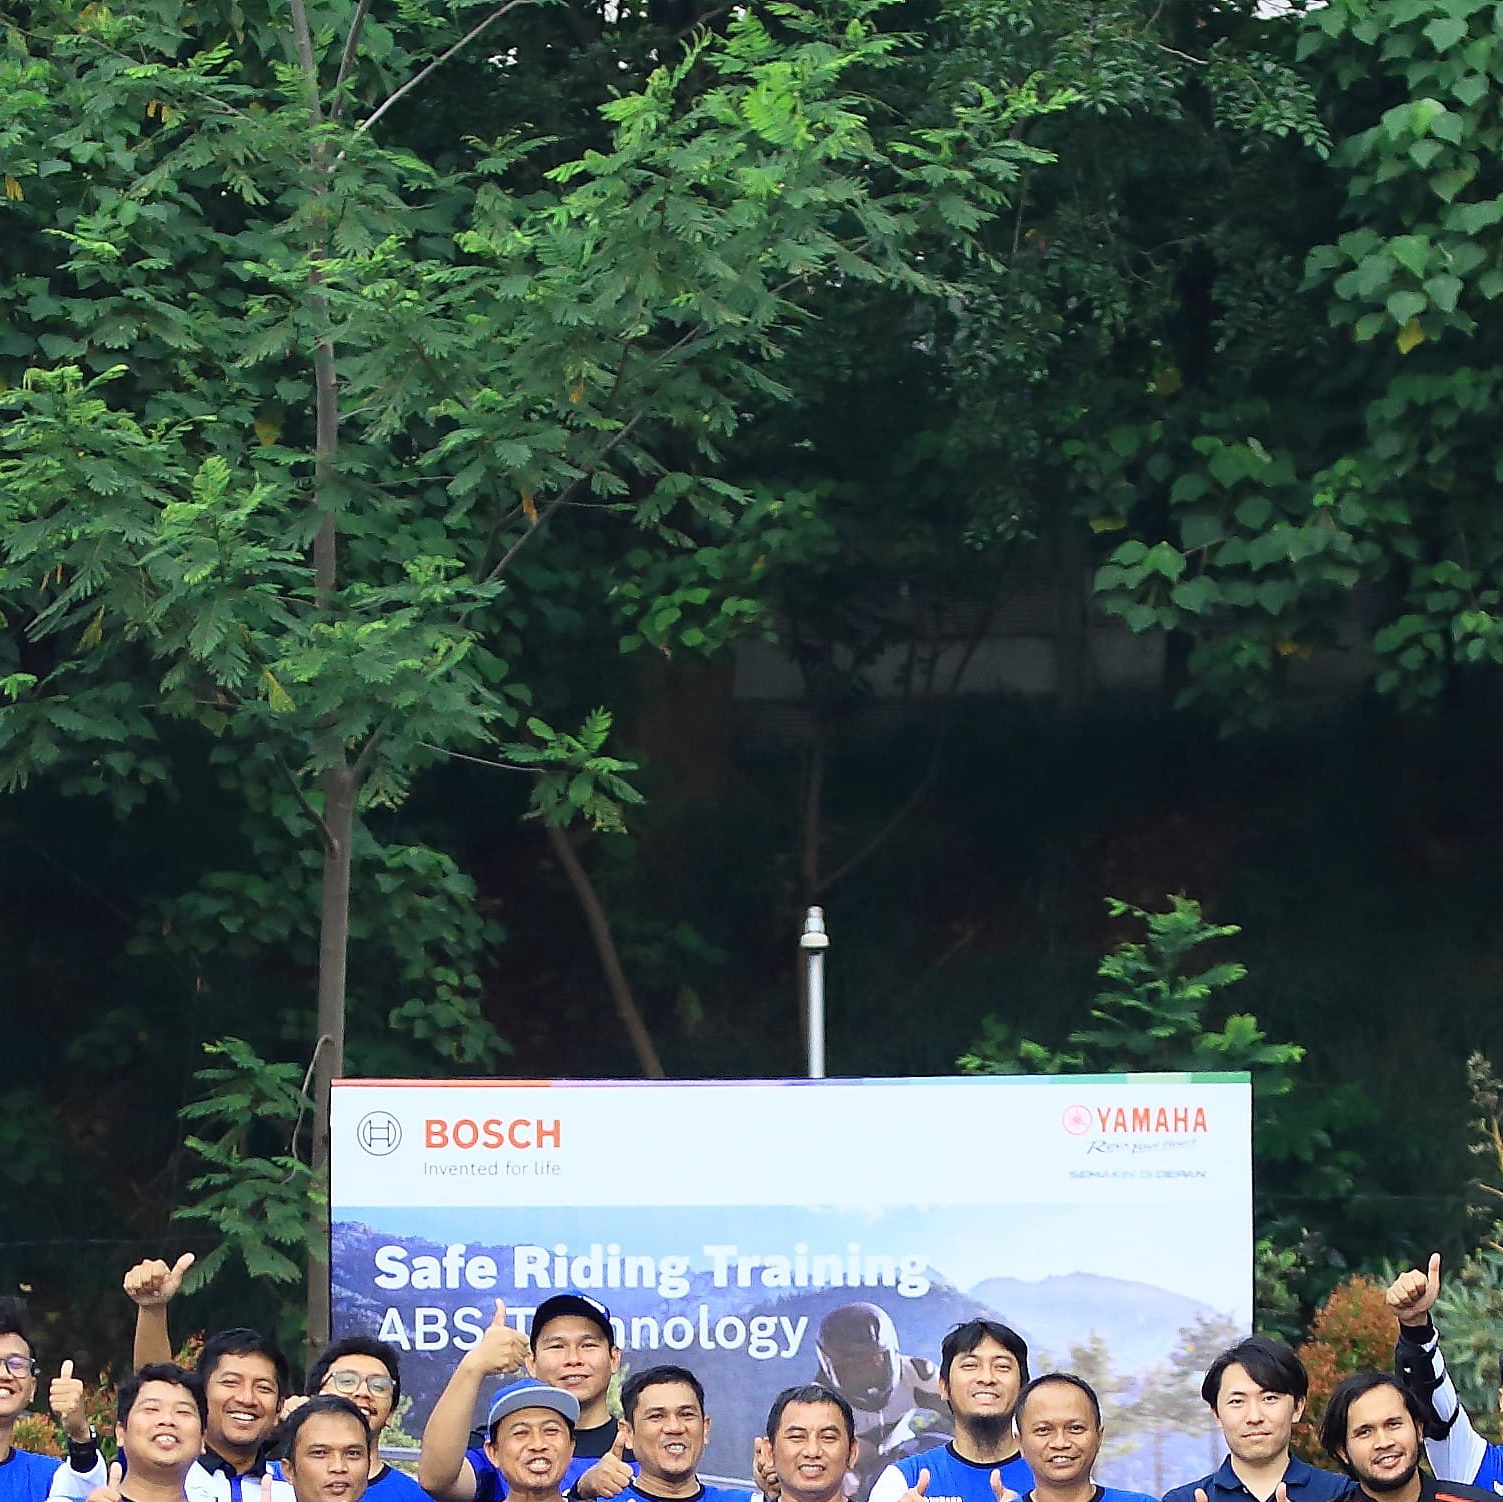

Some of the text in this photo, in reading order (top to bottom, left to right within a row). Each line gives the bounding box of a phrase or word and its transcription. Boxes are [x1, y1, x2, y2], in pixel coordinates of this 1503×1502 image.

[424, 1118, 561, 1149] BOSCH
[1096, 1106, 1208, 1133] YAMAHA
[424, 1161, 561, 1176] Invented for life
[373, 1241, 931, 1299] Safe Riding Training
[377, 1303, 809, 1360] ABS Tnology
